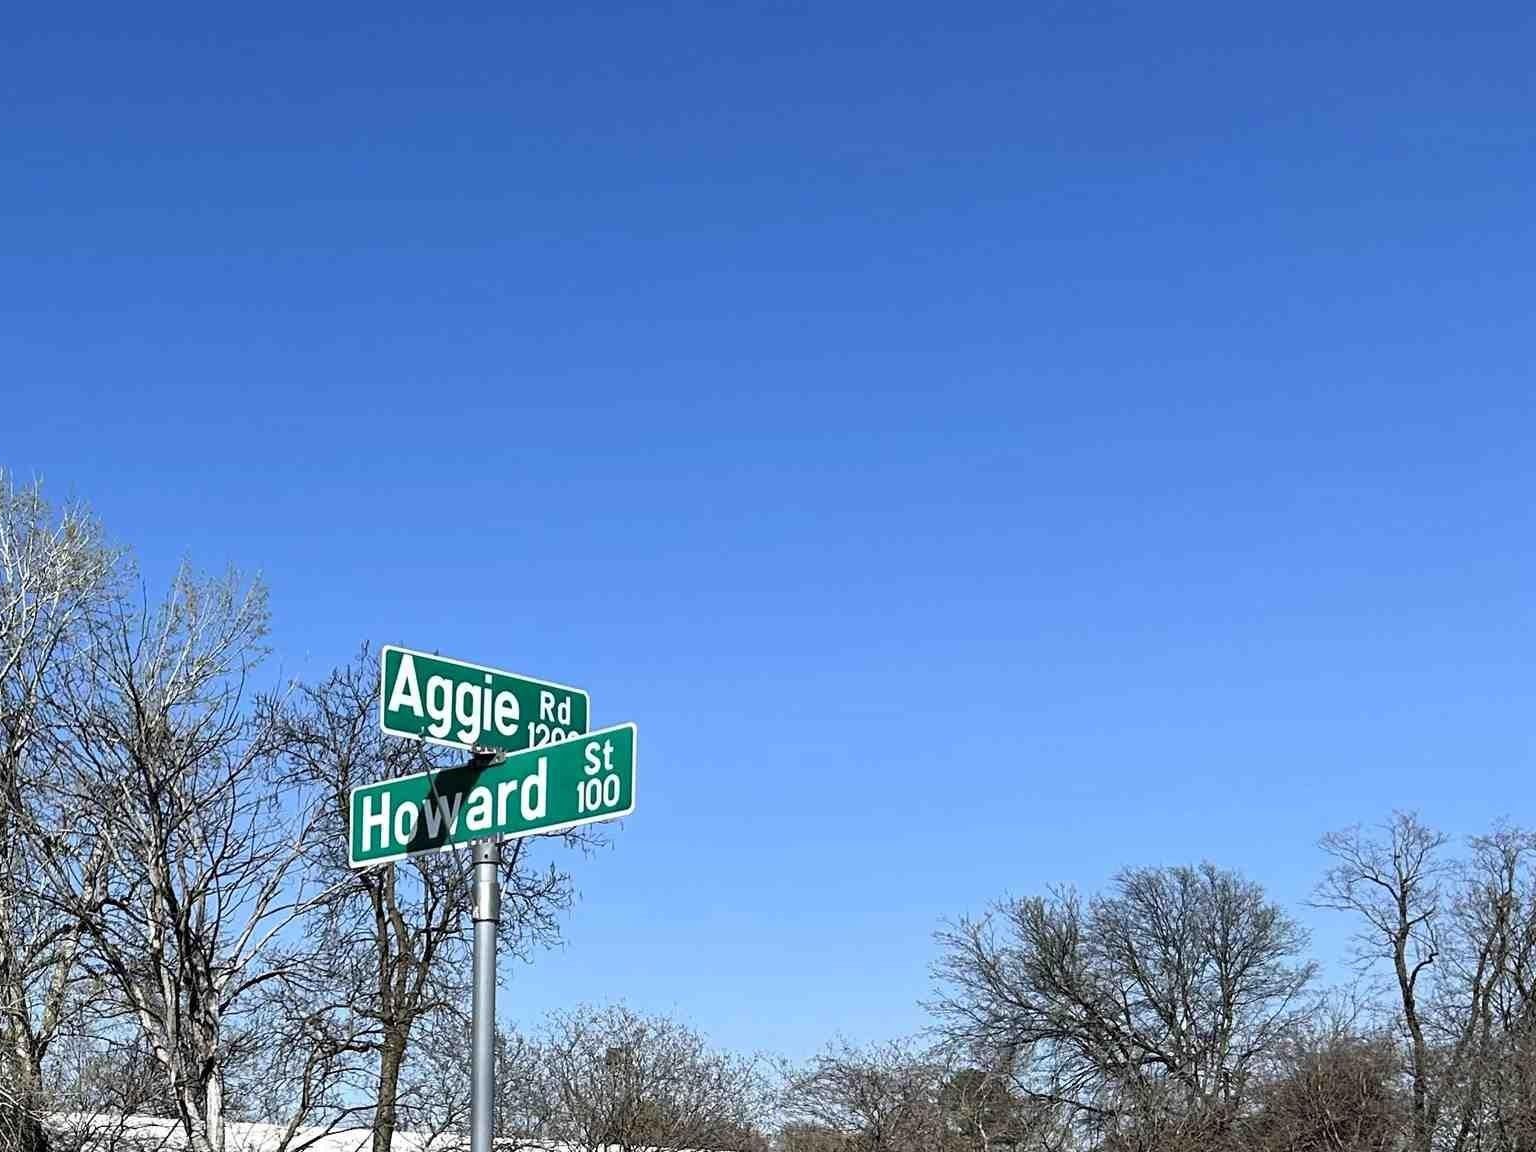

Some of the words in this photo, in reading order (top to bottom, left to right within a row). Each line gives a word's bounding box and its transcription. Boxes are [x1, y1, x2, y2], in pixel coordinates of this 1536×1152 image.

[388, 653, 520, 745] Aggie
[539, 690, 571, 726] Rd
[527, 722, 579, 749] 120
[362, 756, 548, 852] Howard
[584, 739, 615, 776] St
[576, 774, 621, 814] 100
